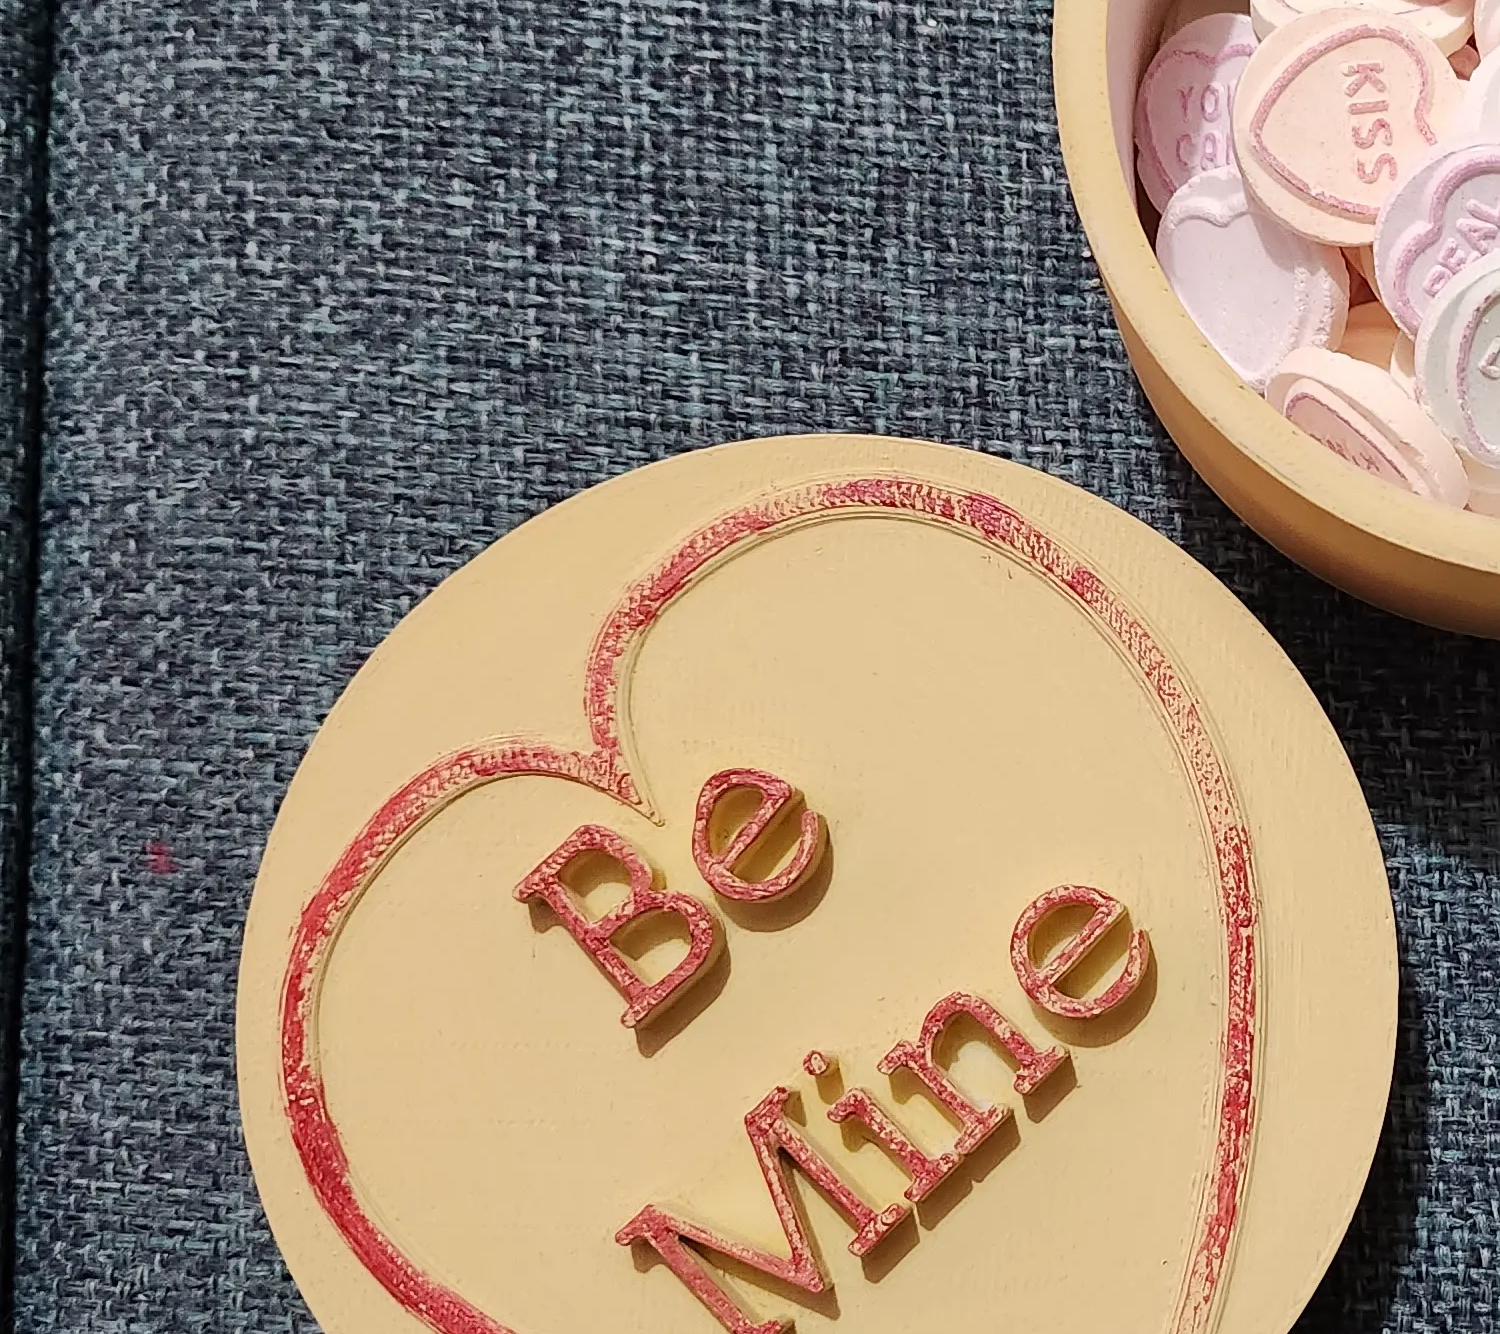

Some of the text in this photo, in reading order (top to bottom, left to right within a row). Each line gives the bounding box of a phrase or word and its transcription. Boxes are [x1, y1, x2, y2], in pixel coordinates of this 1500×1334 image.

[1178, 84, 1233, 124] YO
[1342, 62, 1399, 185] KISS
[1175, 131, 1233, 171] CA
[512, 767, 828, 1037] Be
